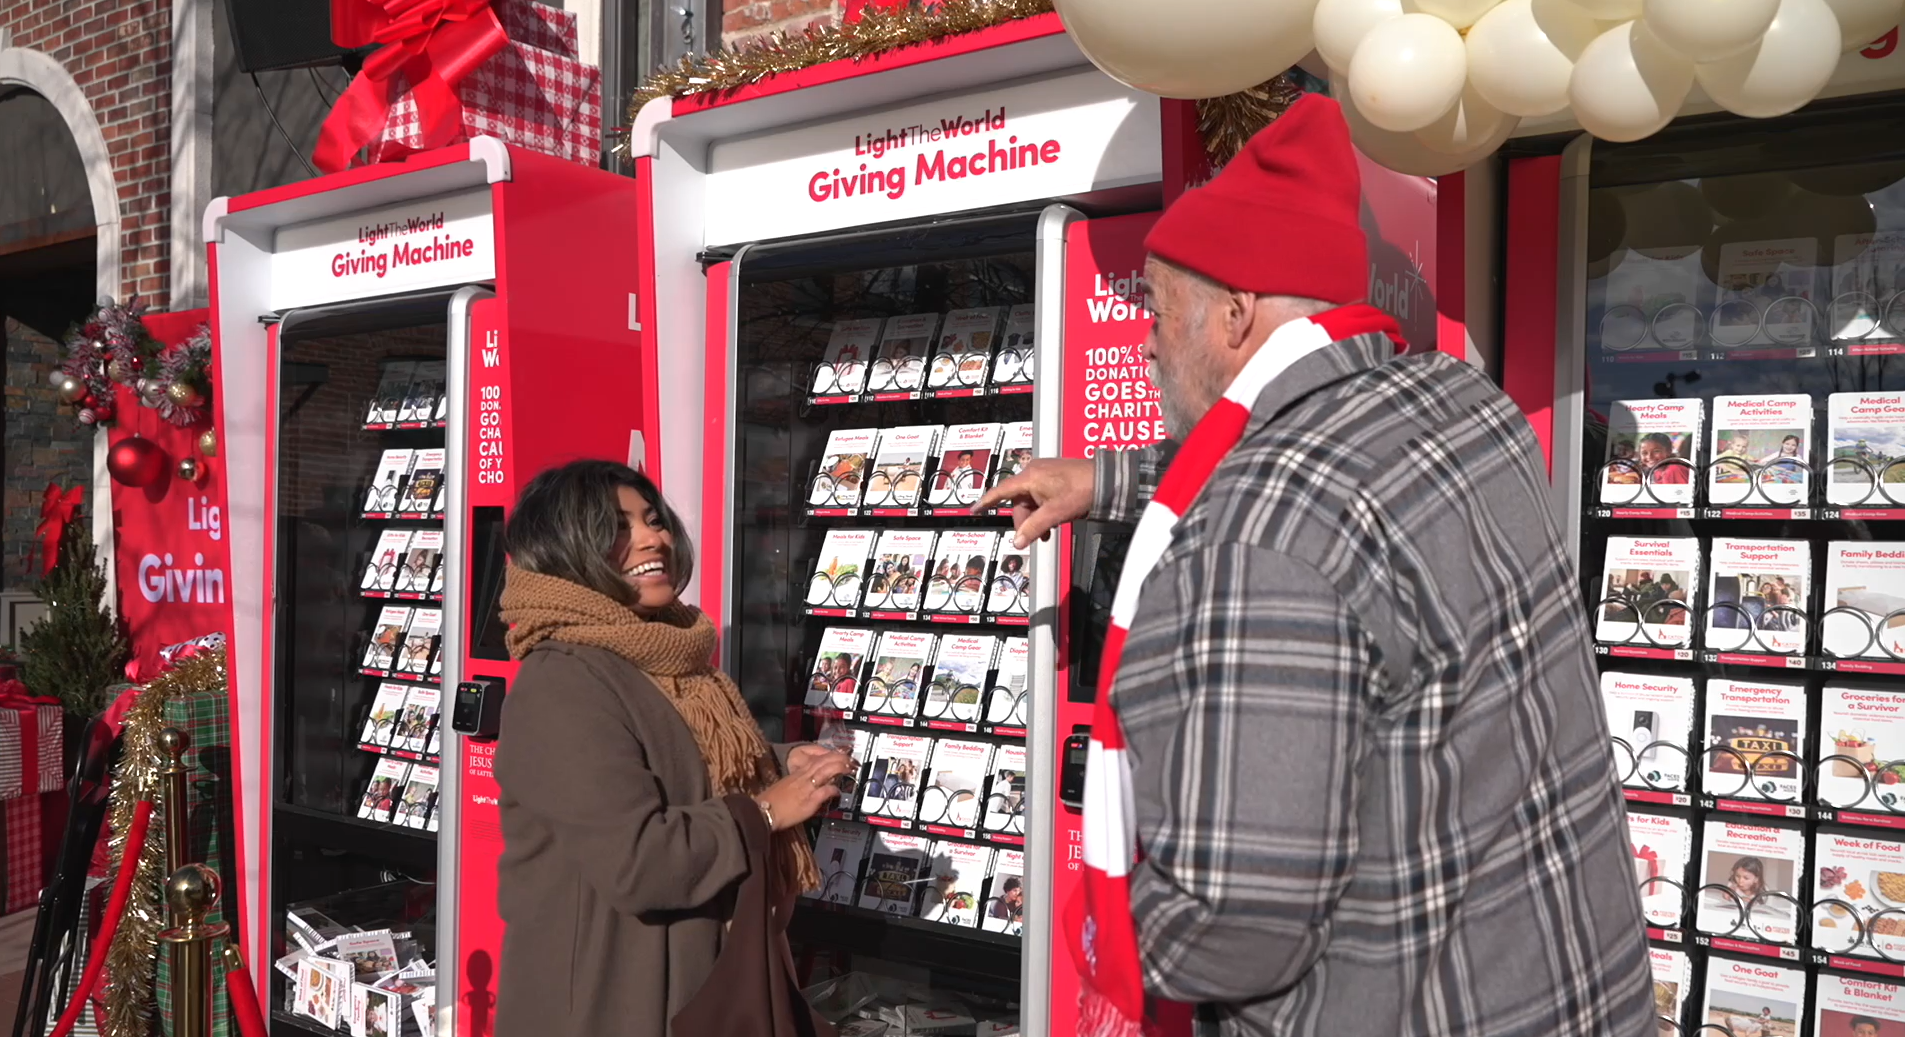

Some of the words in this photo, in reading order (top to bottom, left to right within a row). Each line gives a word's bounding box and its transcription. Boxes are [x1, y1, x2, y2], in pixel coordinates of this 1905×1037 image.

[855, 106, 1005, 159] LightTheWorld
[808, 163, 905, 202] Giving
[915, 135, 1061, 185] Machine
[359, 212, 444, 246] LightTheWorld
[332, 249, 387, 278] Giving
[392, 234, 473, 268] Machine
[1086, 298, 1155, 323] Worl
[486, 330, 498, 348] Li
[1085, 345, 1134, 367] 100%
[1085, 381, 1147, 401] GOES
[1727, 400, 1765, 408] Medical
[1767, 400, 1797, 408] Camp
[1860, 397, 1900, 405] Medical
[1084, 402, 1163, 419] CHARITY
[1626, 405, 1655, 414] Hearty
[1657, 404, 1684, 413] Camp
[1740, 408, 1783, 416] Activities
[1851, 405, 1882, 414] Camp
[480, 412, 502, 426] GO
[1083, 420, 1166, 442] CAUSE
[479, 458, 493, 469] OF
[478, 471, 504, 484] CHO
[188, 496, 221, 540] Lig
[1634, 540, 1670, 548] Survival
[1726, 543, 1795, 552] Transportation
[1630, 549, 1673, 557] Essentials
[1740, 552, 1779, 561] Support
[1840, 550, 1873, 560] Family
[138, 552, 225, 603] Givin
[1595, 647, 1608, 655] 130
[1822, 662, 1836, 670] 134
[1615, 682, 1640, 690] Home
[1642, 684, 1679, 694] Security
[1729, 685, 1782, 697] Emergency
[1721, 693, 1790, 704] Transportation
[1841, 692, 1890, 703] Groceries
[1857, 703, 1900, 713] Survivor
[469, 744, 484, 755] THE
[944, 742, 961, 751] Family
[962, 744, 985, 753] Bedding
[1743, 741, 1777, 751] TAXI
[469, 755, 493, 769] JESUS
[1700, 800, 1714, 808] 142
[1817, 812, 1833, 820] 144
[1651, 818, 1670, 826] Kids
[1727, 830, 1777, 843] Recreation
[1834, 838, 1861, 848] Week
[1863, 839, 1874, 849] of
[1876, 842, 1901, 852] Food
[1006, 852, 1021, 860] Night
[1067, 862, 1080, 871] OF
[1695, 937, 1709, 946] 152
[1812, 955, 1828, 964] 154
[1732, 964, 1752, 974] One
[1754, 968, 1779, 979] Goat
[1839, 977, 1882, 990] Comfort
[1884, 983, 1898, 993] Kit
[1844, 987, 1852, 996] &
[1853, 988, 1893, 1002] Blanket
